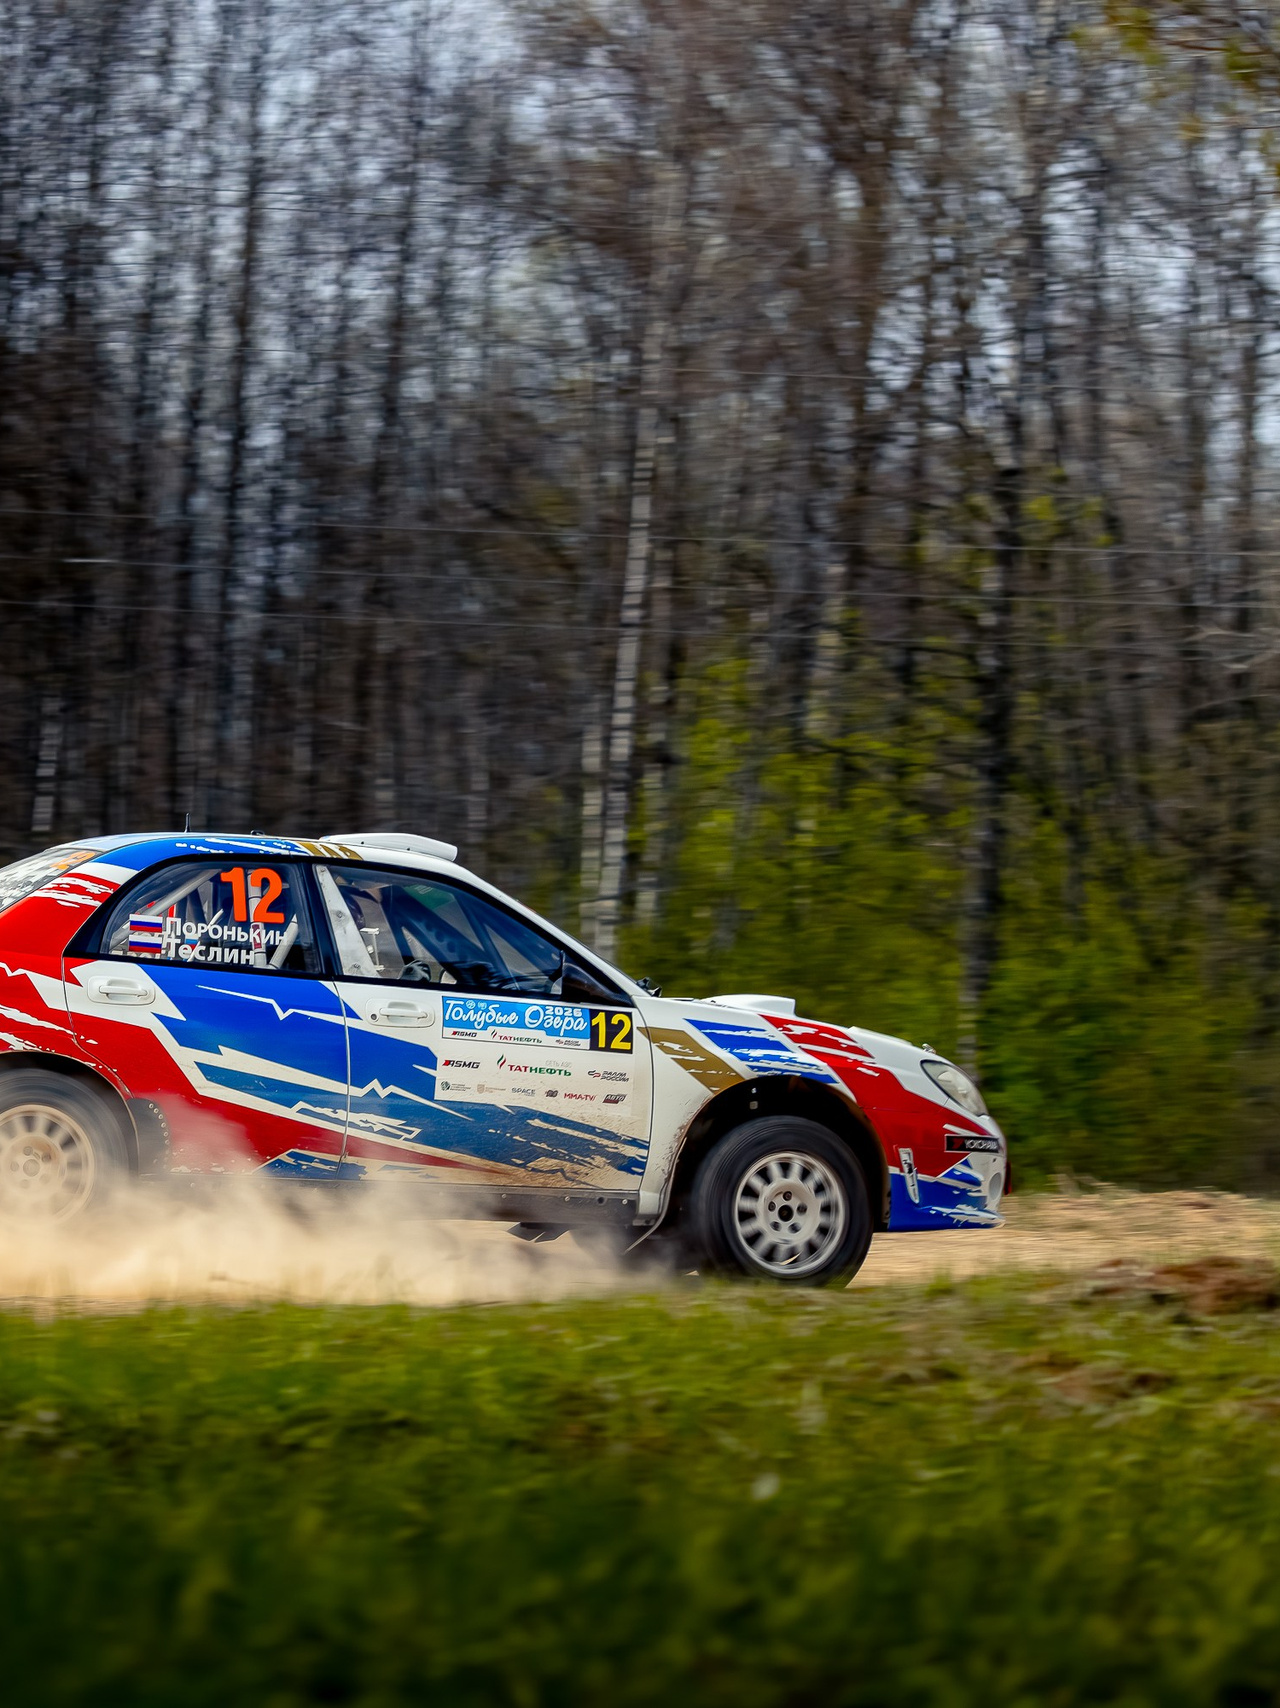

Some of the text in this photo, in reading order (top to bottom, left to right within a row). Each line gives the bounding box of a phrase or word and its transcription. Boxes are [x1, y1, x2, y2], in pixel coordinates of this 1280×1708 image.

[221, 867, 285, 923] 12
[166, 917, 288, 946] Поронькин
[166, 938, 255, 965] Теслин
[445, 1000, 588, 1037] Голубые Озера
[544, 1005, 582, 1017] 2026
[498, 1035, 543, 1044] ТАТНЕФТЬ
[591, 1012, 632, 1050] 12
[507, 1064, 572, 1077] ТАТНЕФТЬ
